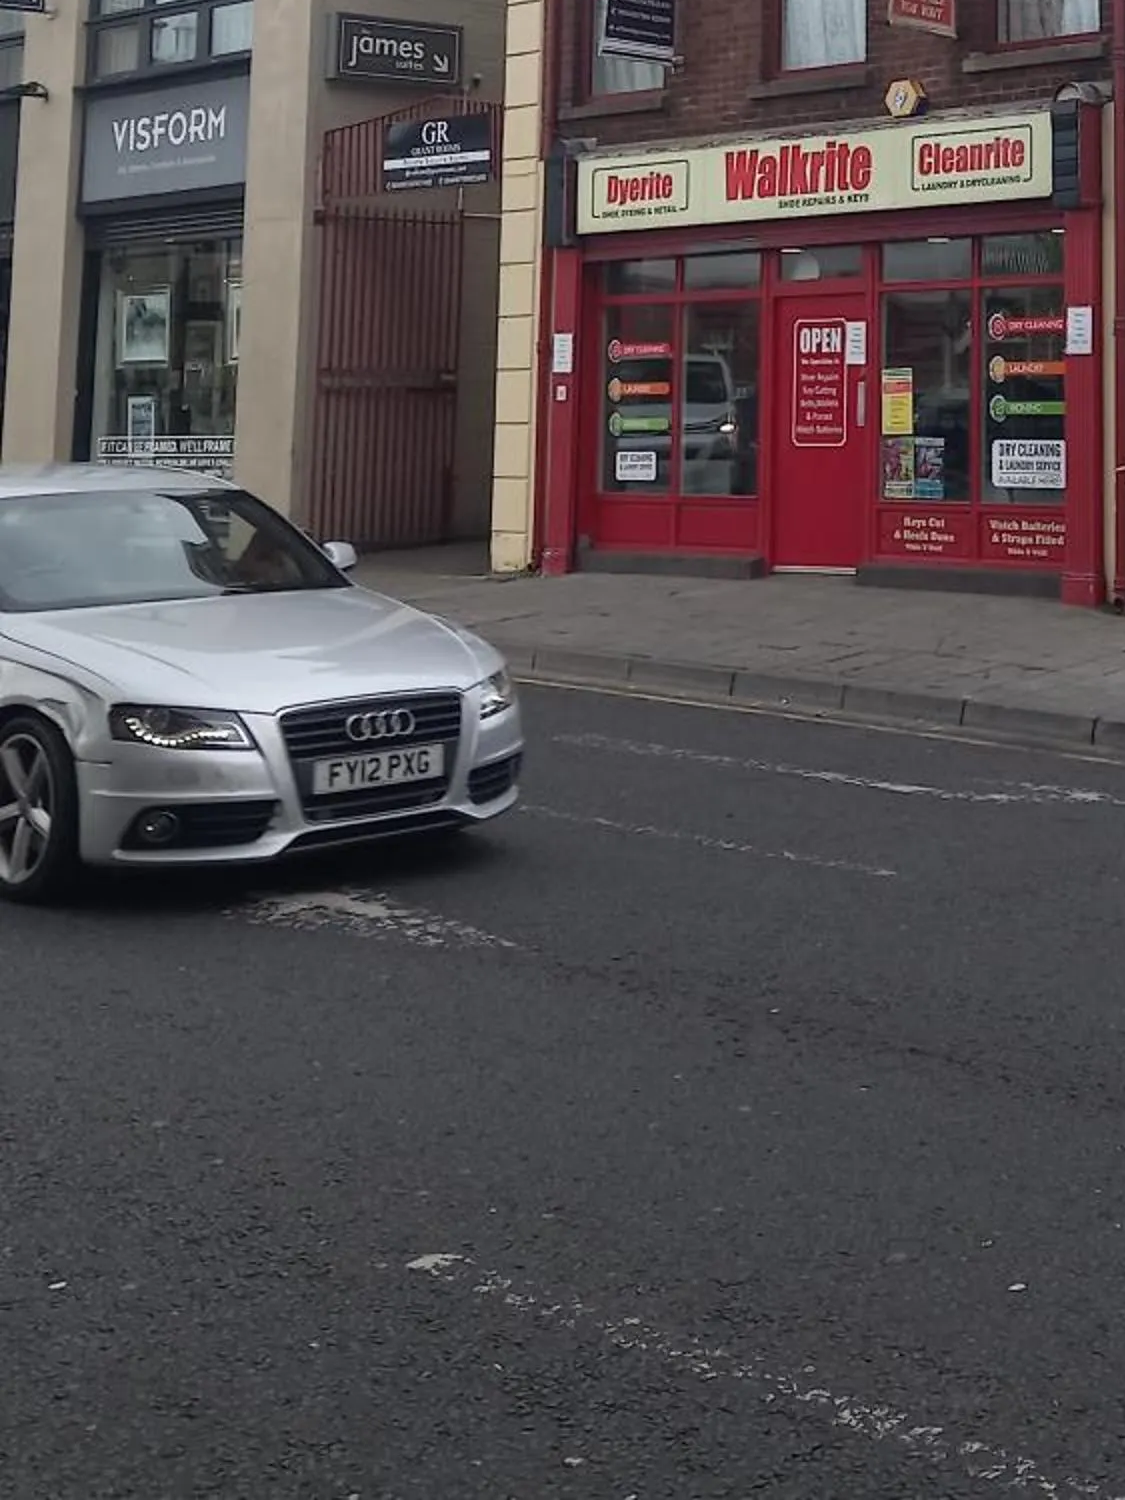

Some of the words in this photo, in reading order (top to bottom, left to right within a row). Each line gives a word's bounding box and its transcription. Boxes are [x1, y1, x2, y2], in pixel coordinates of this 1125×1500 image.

[112, 105, 227, 153] VISFORM
[422, 121, 450, 145] GR
[918, 136, 1025, 176] Cleanrite
[724, 140, 872, 201] Walkrite
[607, 171, 673, 205] Dyerite
[921, 181, 957, 191] LAUNDRY
[653, 205, 677, 215] RETAIL
[778, 199, 801, 209] SHOE
[802, 195, 836, 207] REPAIRS
[838, 195, 845, 204] &
[847, 193, 869, 203] KEYS
[1024, 319, 1064, 330] CLEANING
[800, 327, 842, 353] OPEN
[999, 443, 1017, 457] DRY
[1018, 443, 1061, 457] CLEANING
[1005, 459, 1034, 470] LAUNDRY
[1021, 520, 1066, 533] Batteries
[328, 757, 381, 787] FY12
[387, 750, 430, 779] PXG
